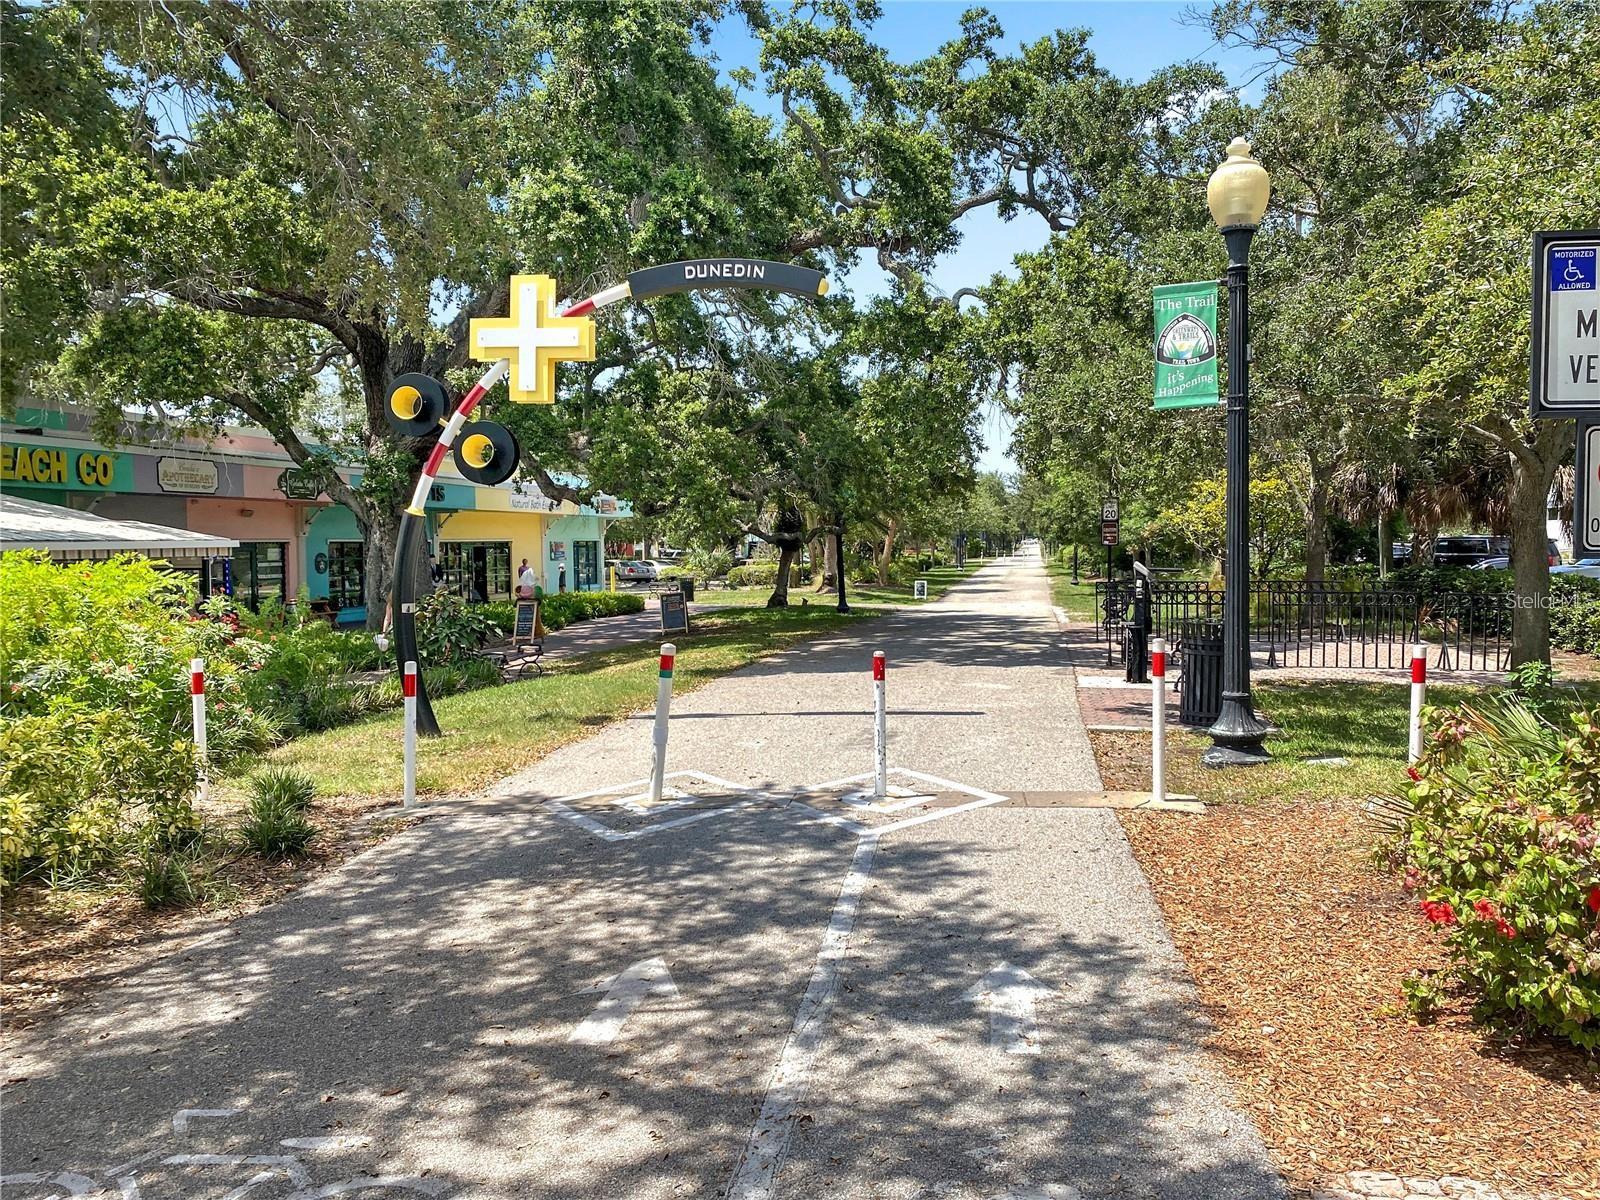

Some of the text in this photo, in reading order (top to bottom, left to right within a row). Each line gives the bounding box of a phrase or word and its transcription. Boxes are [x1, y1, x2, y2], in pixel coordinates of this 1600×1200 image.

[1554, 250, 1594, 259] MOTORIZED
[684, 263, 765, 279] DUNEDIN
[1558, 282, 1591, 290] ALLOWED
[1157, 294, 1215, 311] The Trail
[1577, 309, 1598, 338] M
[1168, 370, 1185, 384] it's
[1569, 355, 1599, 384] VE
[1158, 374, 1214, 397] Happening
[0, 445, 114, 486] EACH CO
[1104, 510, 1116, 519] 20
